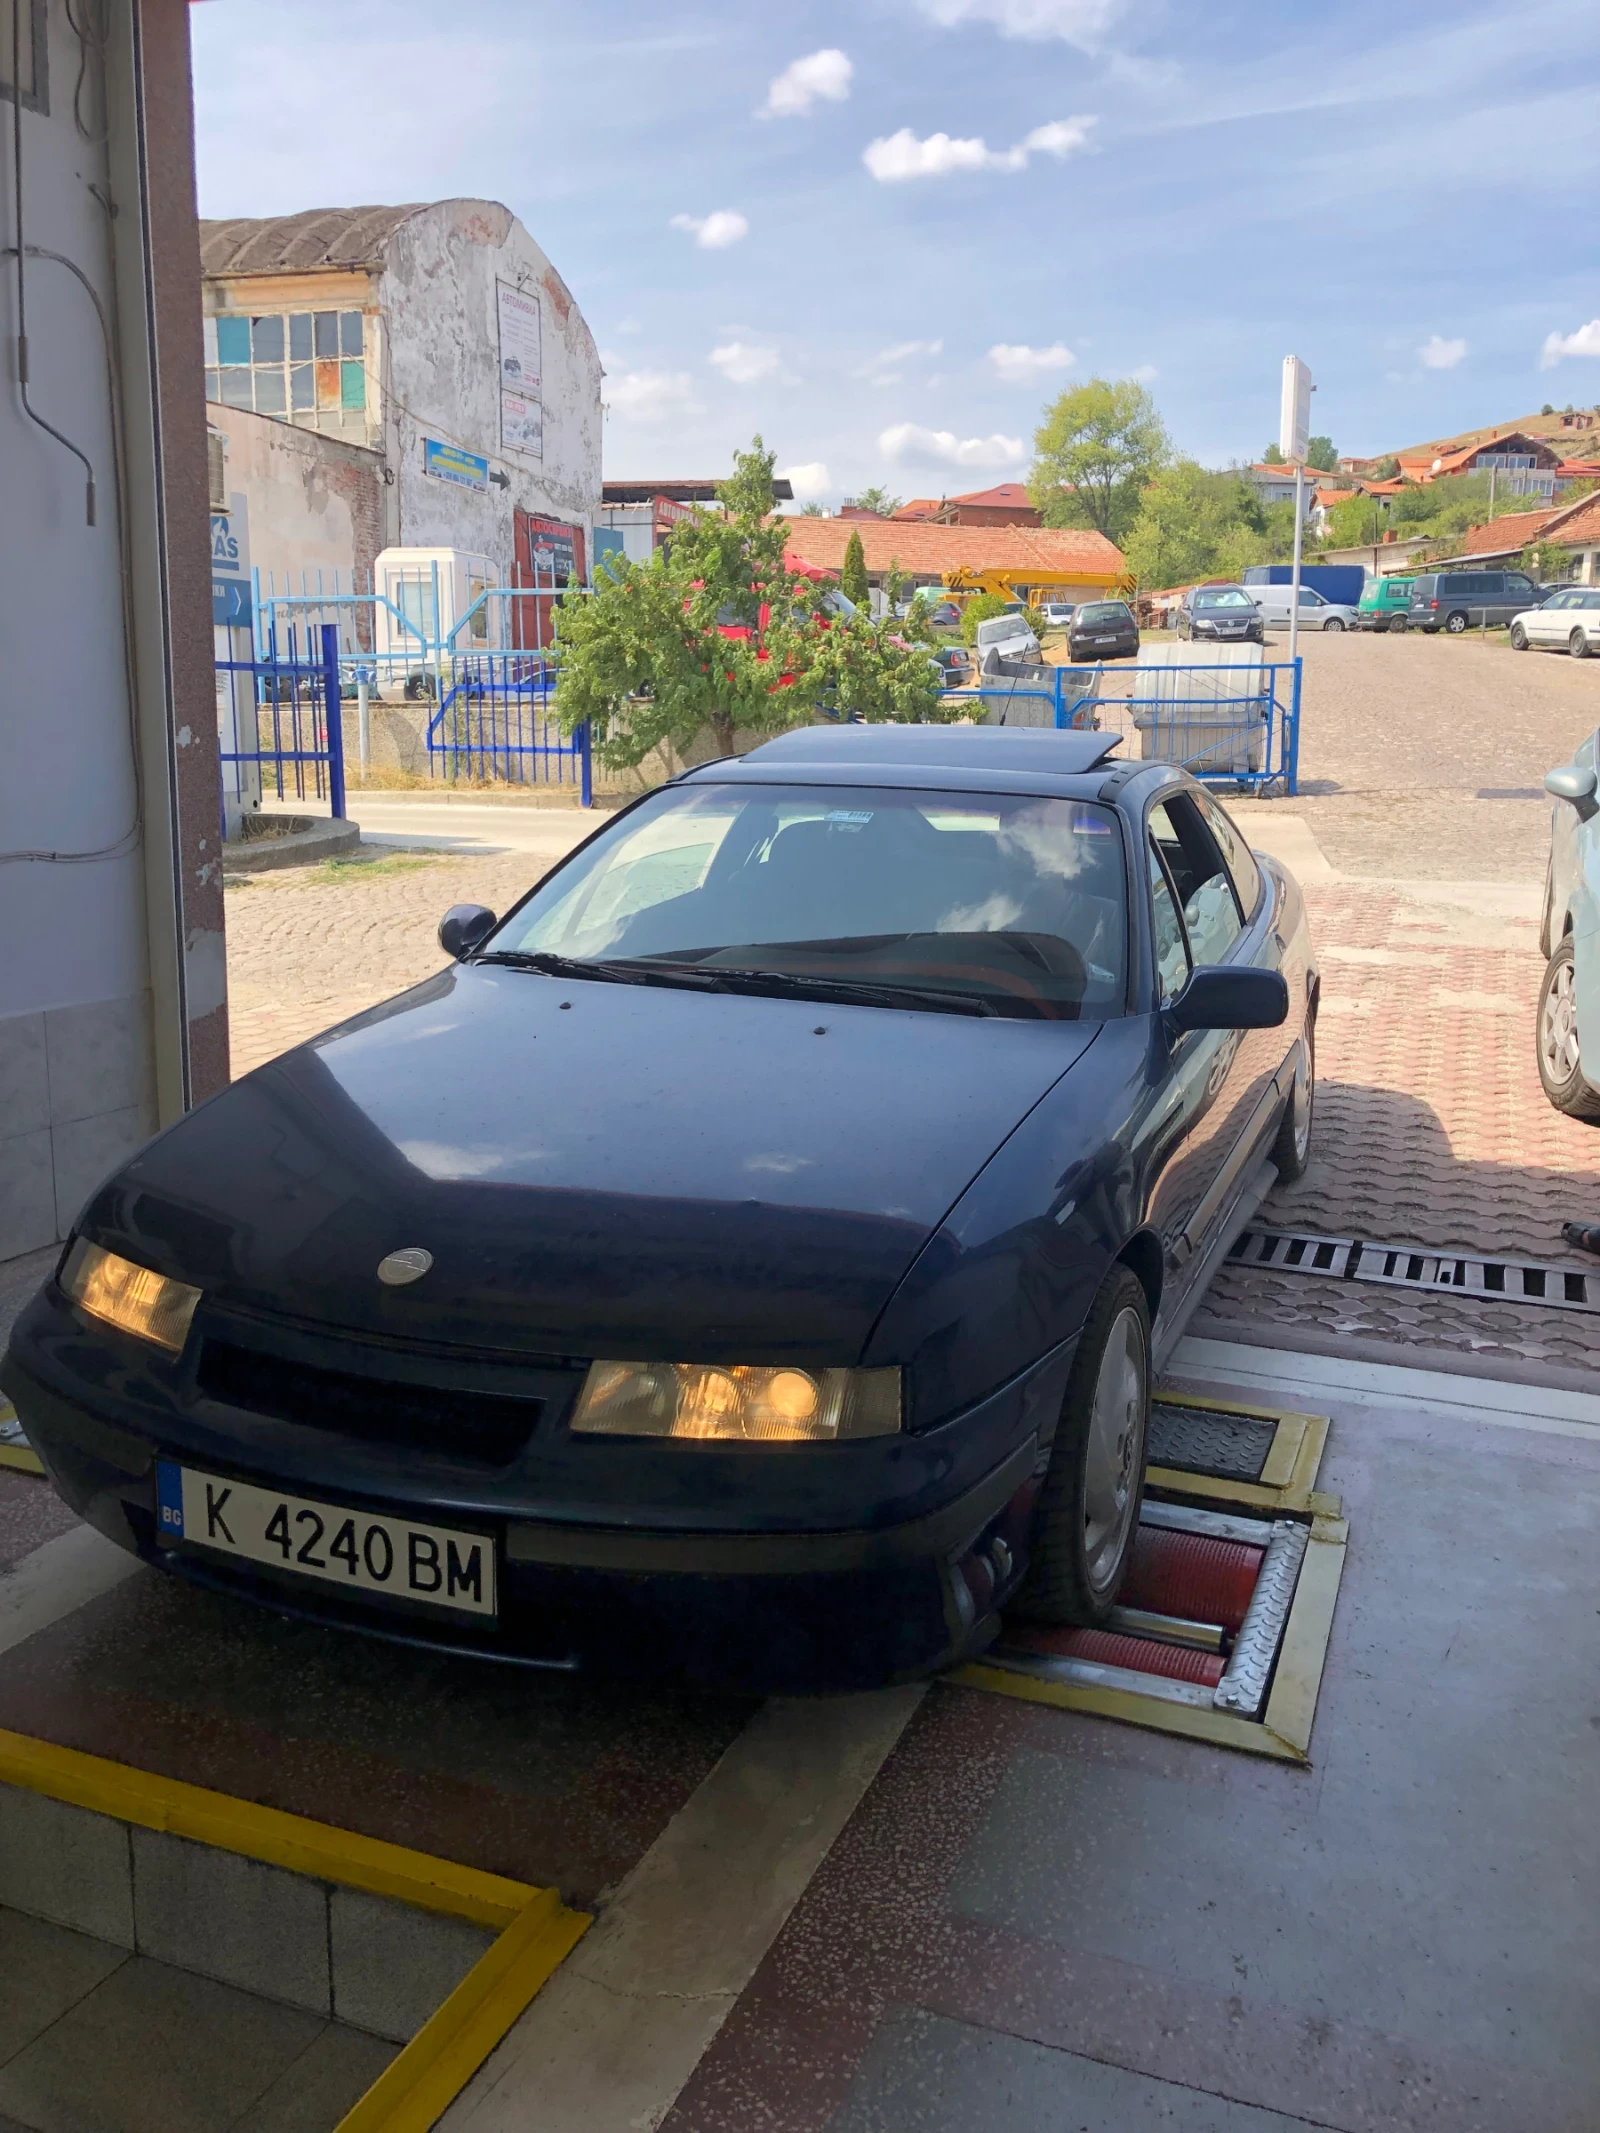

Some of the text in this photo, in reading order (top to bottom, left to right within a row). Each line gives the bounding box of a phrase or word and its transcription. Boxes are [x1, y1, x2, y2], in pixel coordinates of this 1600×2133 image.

[501, 292, 536, 316] АВТОМИВКА
[213, 535, 239, 559] AS
[162, 1505, 182, 1527] BG
[206, 1483, 482, 1603] K 4240 BM
